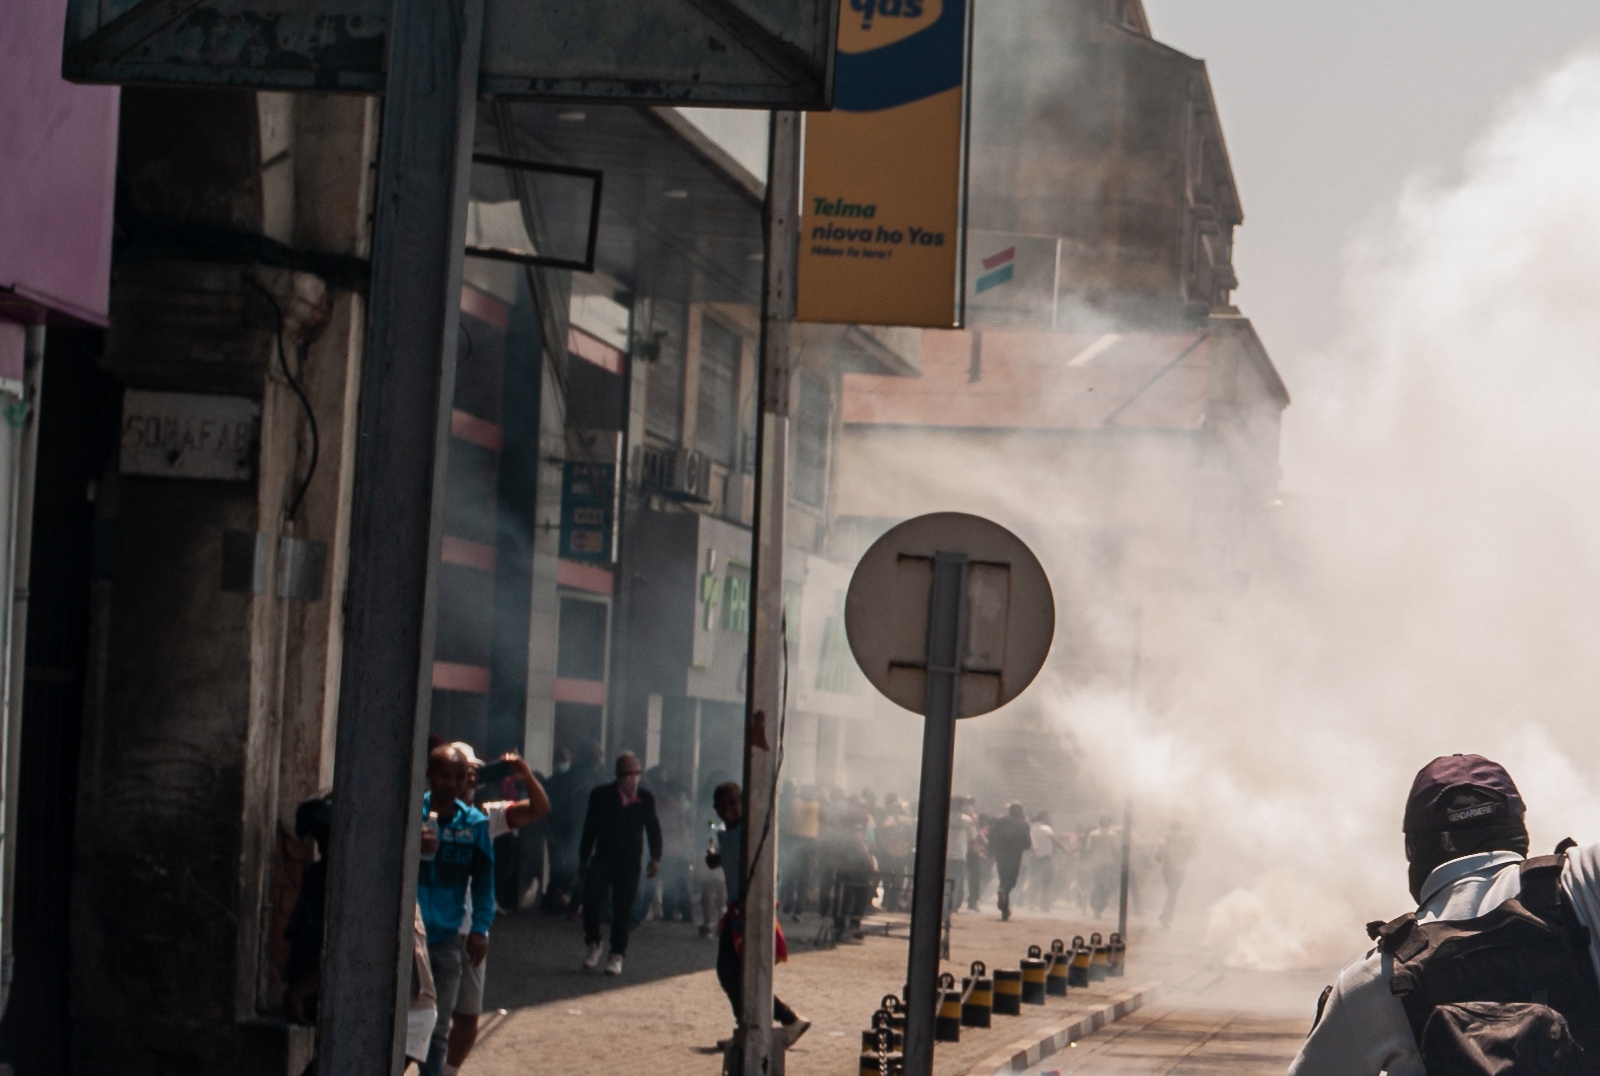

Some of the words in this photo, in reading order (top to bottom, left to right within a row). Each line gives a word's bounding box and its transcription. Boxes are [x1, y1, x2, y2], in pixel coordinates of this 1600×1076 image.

[813, 197, 877, 218] Telma
[811, 222, 873, 242] niova
[875, 224, 903, 244] ho
[908, 226, 945, 247] Yas
[1448, 805, 1494, 822] GENDARMERIE
